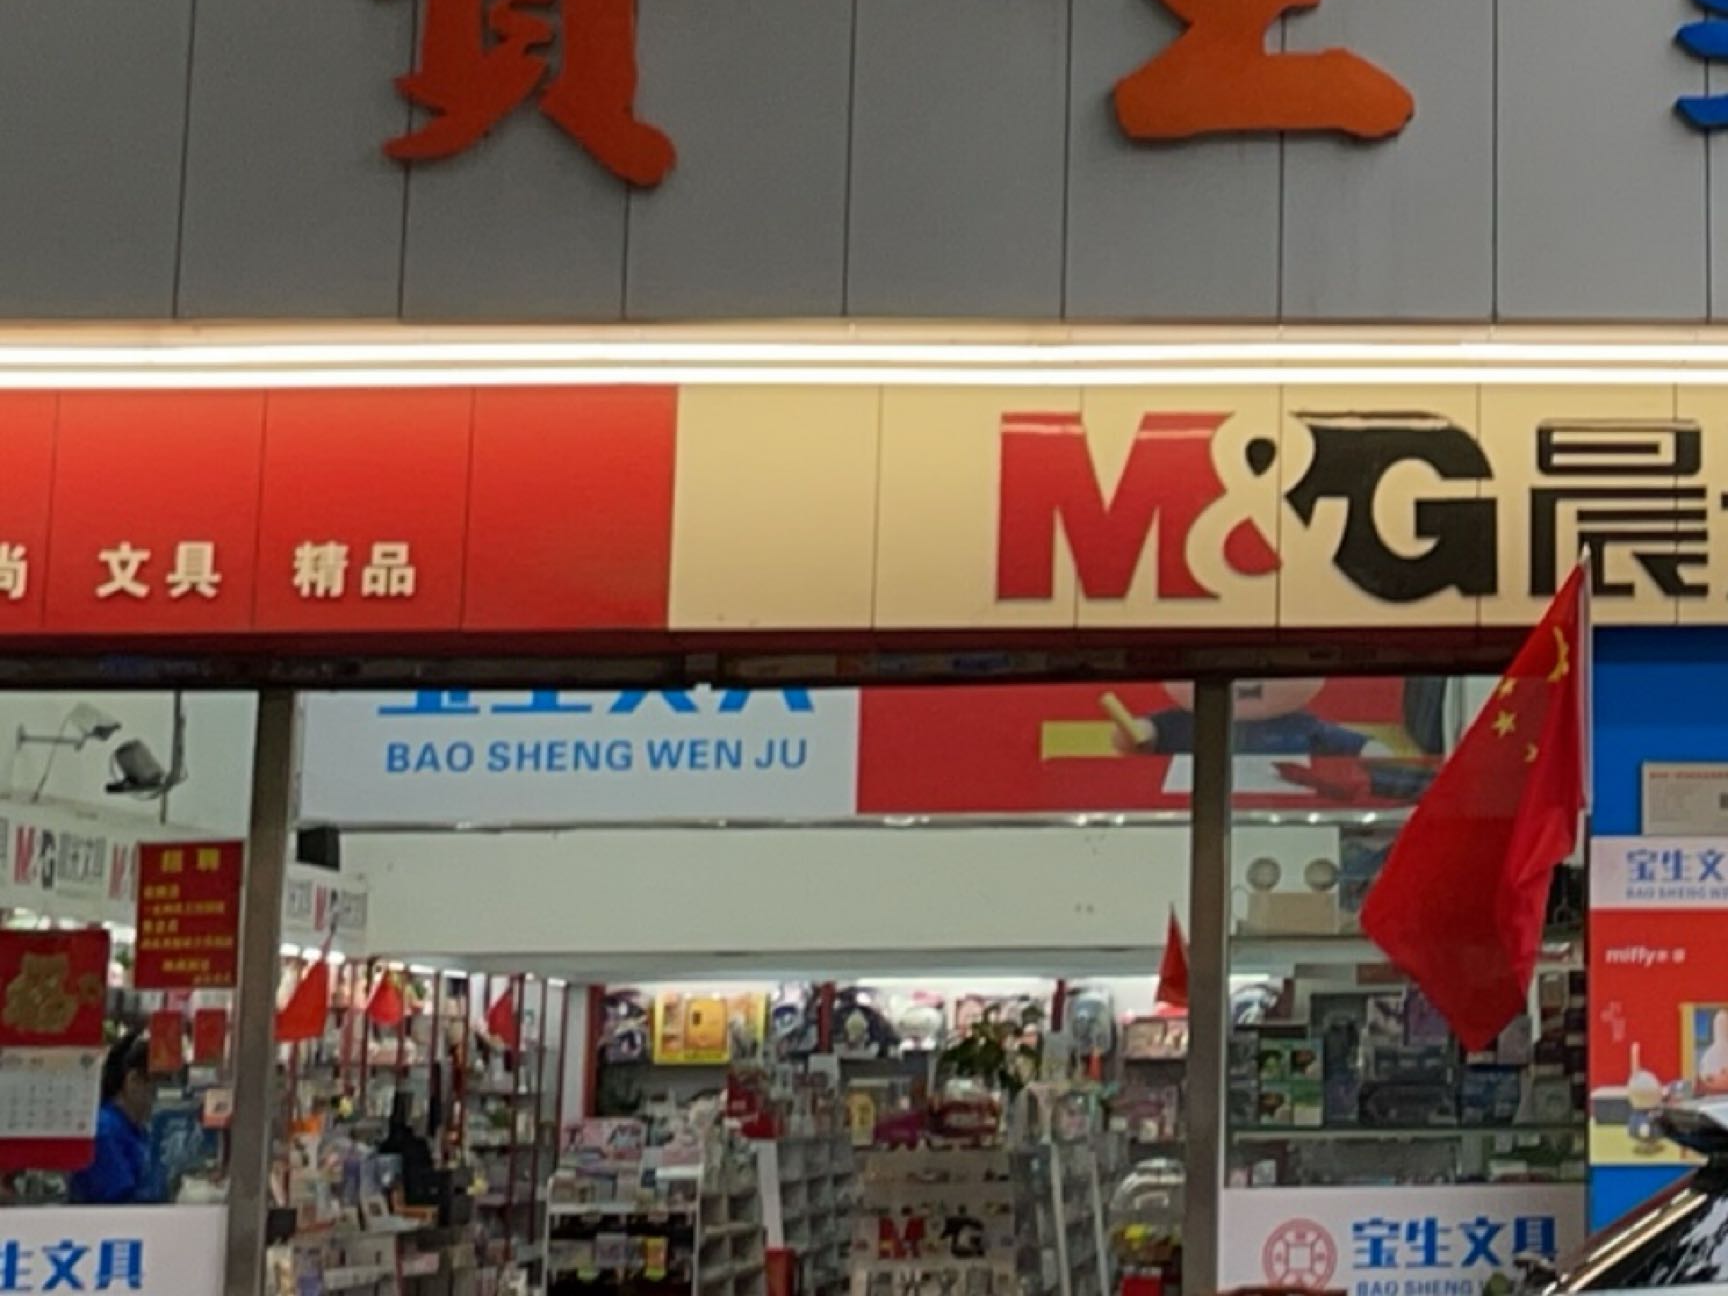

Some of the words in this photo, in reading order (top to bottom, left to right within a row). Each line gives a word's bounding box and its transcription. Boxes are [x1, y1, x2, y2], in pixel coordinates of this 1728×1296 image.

[998, 411, 1497, 601] M&G
[95, 542, 221, 598] 文具
[293, 542, 416, 597] 精品
[385, 741, 474, 773] BAO
[487, 739, 632, 772] SHENG
[647, 738, 742, 770] WEN
[755, 738, 806, 769] JU
[1351, 1215, 1556, 1270] 宝生文具
